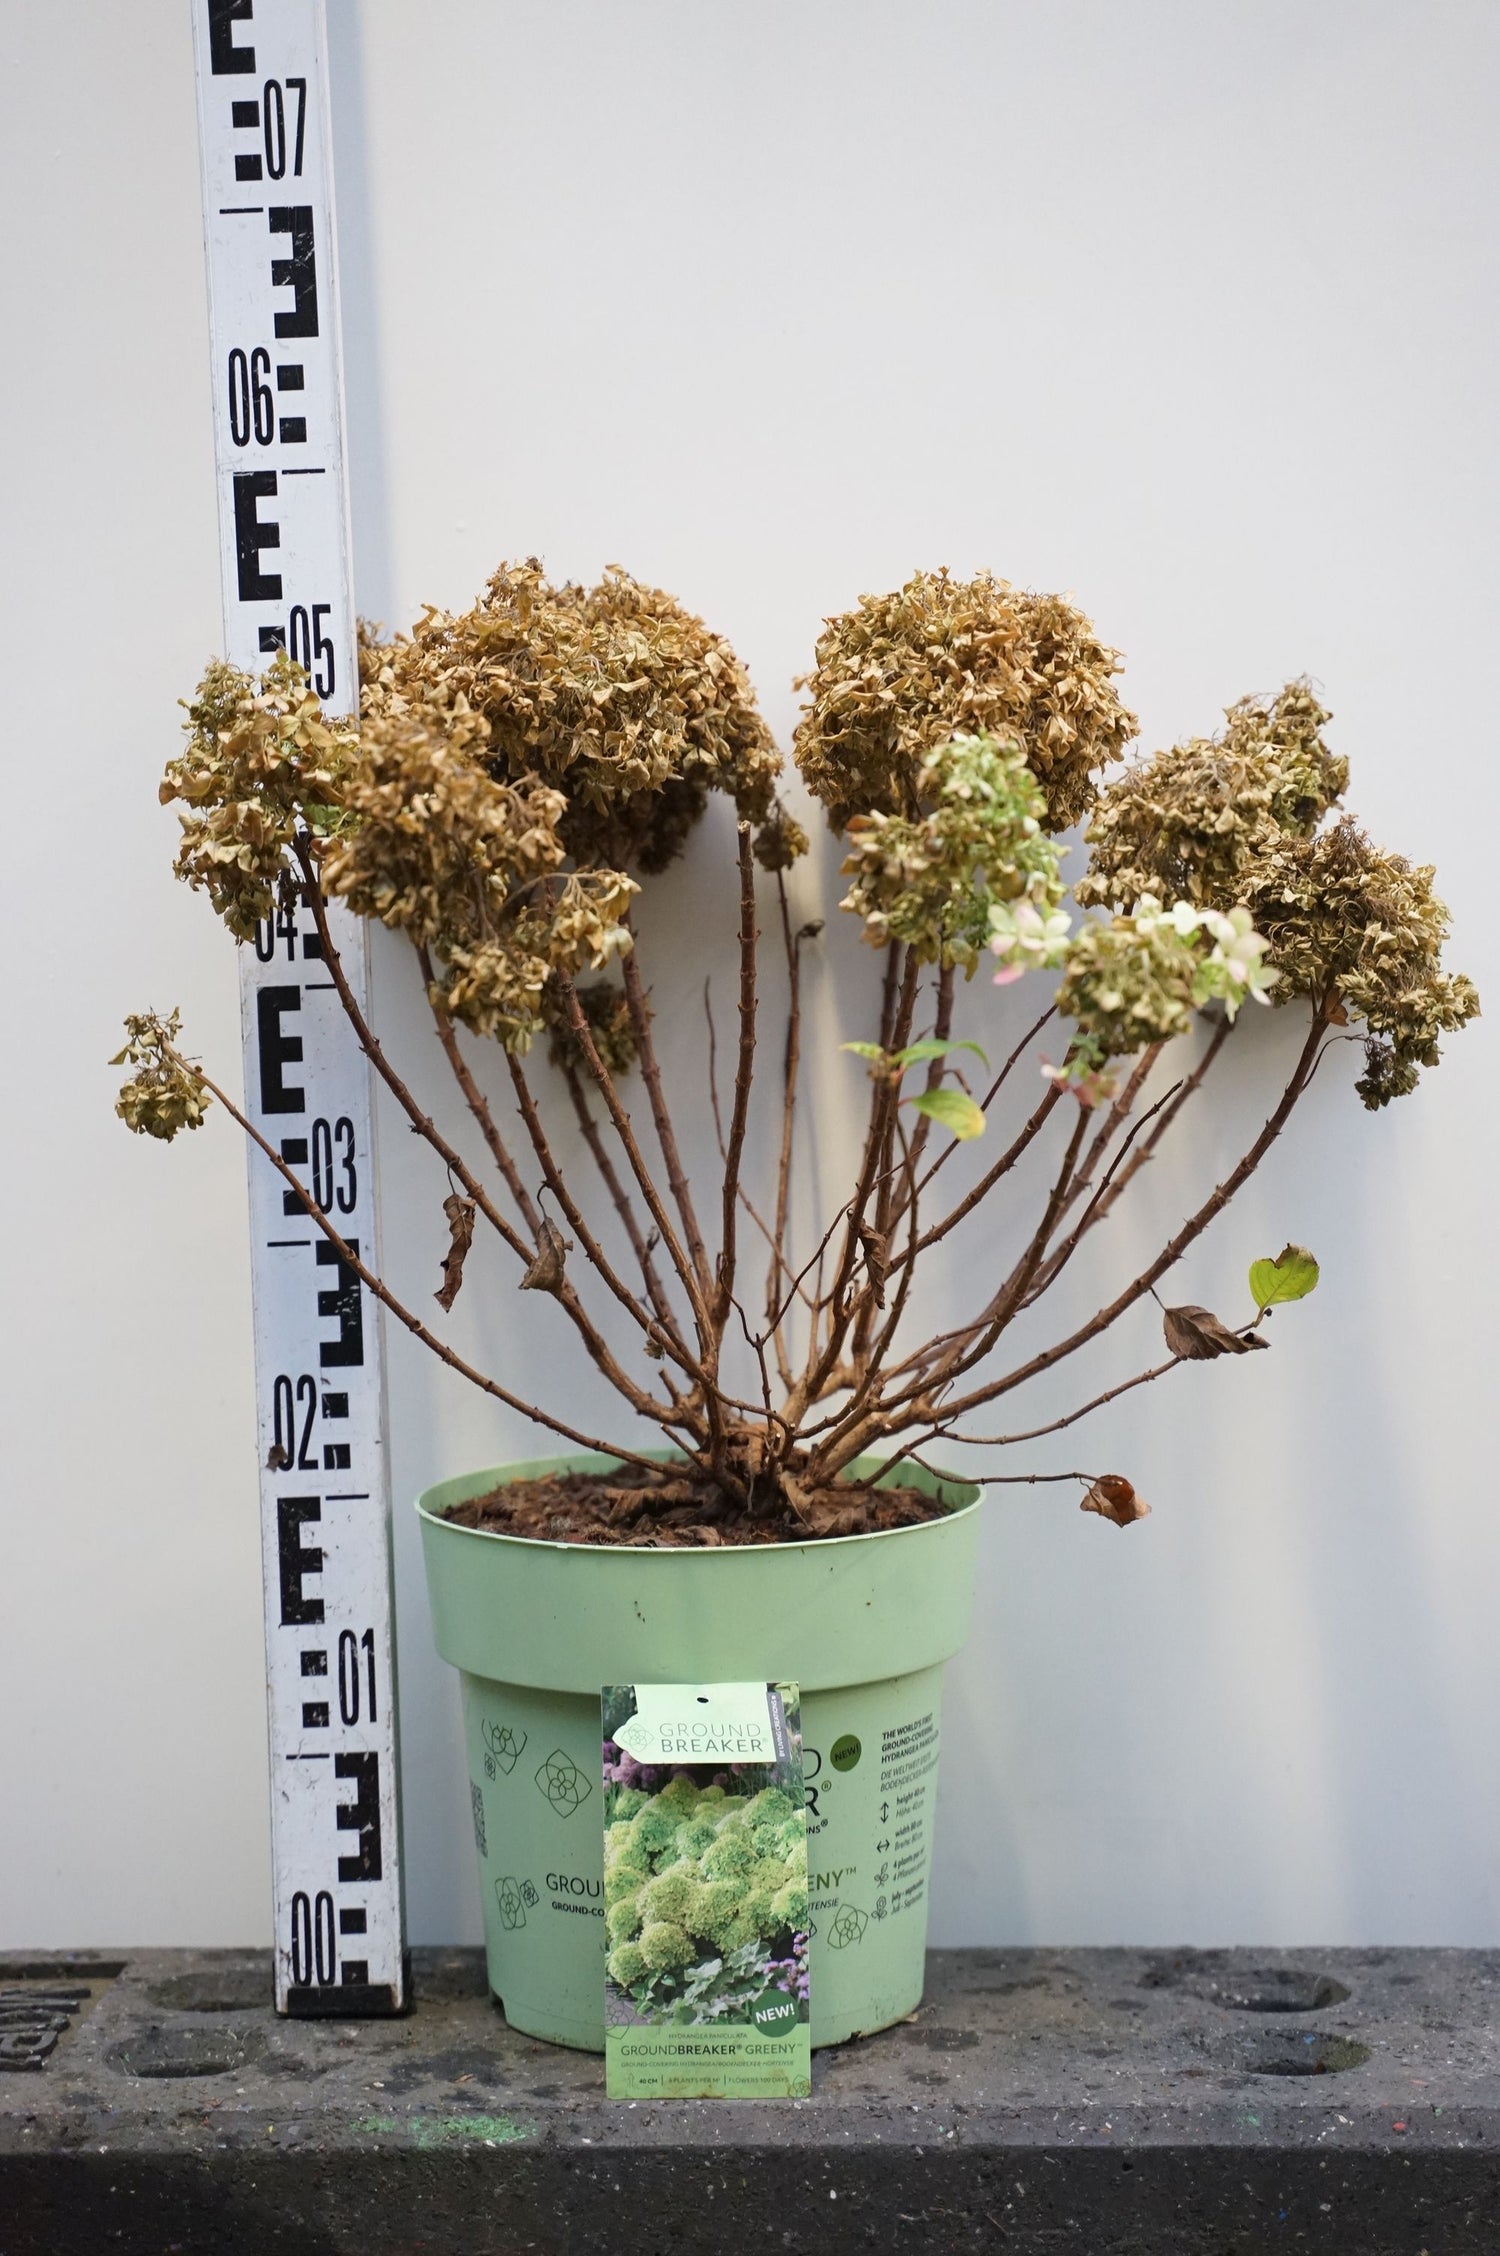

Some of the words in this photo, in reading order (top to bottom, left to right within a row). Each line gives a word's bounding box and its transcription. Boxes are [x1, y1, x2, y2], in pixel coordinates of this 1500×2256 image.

[263, 77, 307, 180] 07
[228, 347, 274, 447] 06
[289, 604, 335, 700] 05
[312, 1117, 357, 1215] 03
[273, 1374, 319, 1472] 02
[339, 1627, 377, 1726] 01
[659, 1722, 762, 1738] GROUND
[776, 1731, 784, 1750] LIVING
[834, 1743, 860, 1762] NEW!
[882, 1728, 897, 1740] THE
[546, 1872, 604, 1898] GROU
[292, 1890, 336, 1987] 00
[755, 2003, 795, 2024] NEW!
